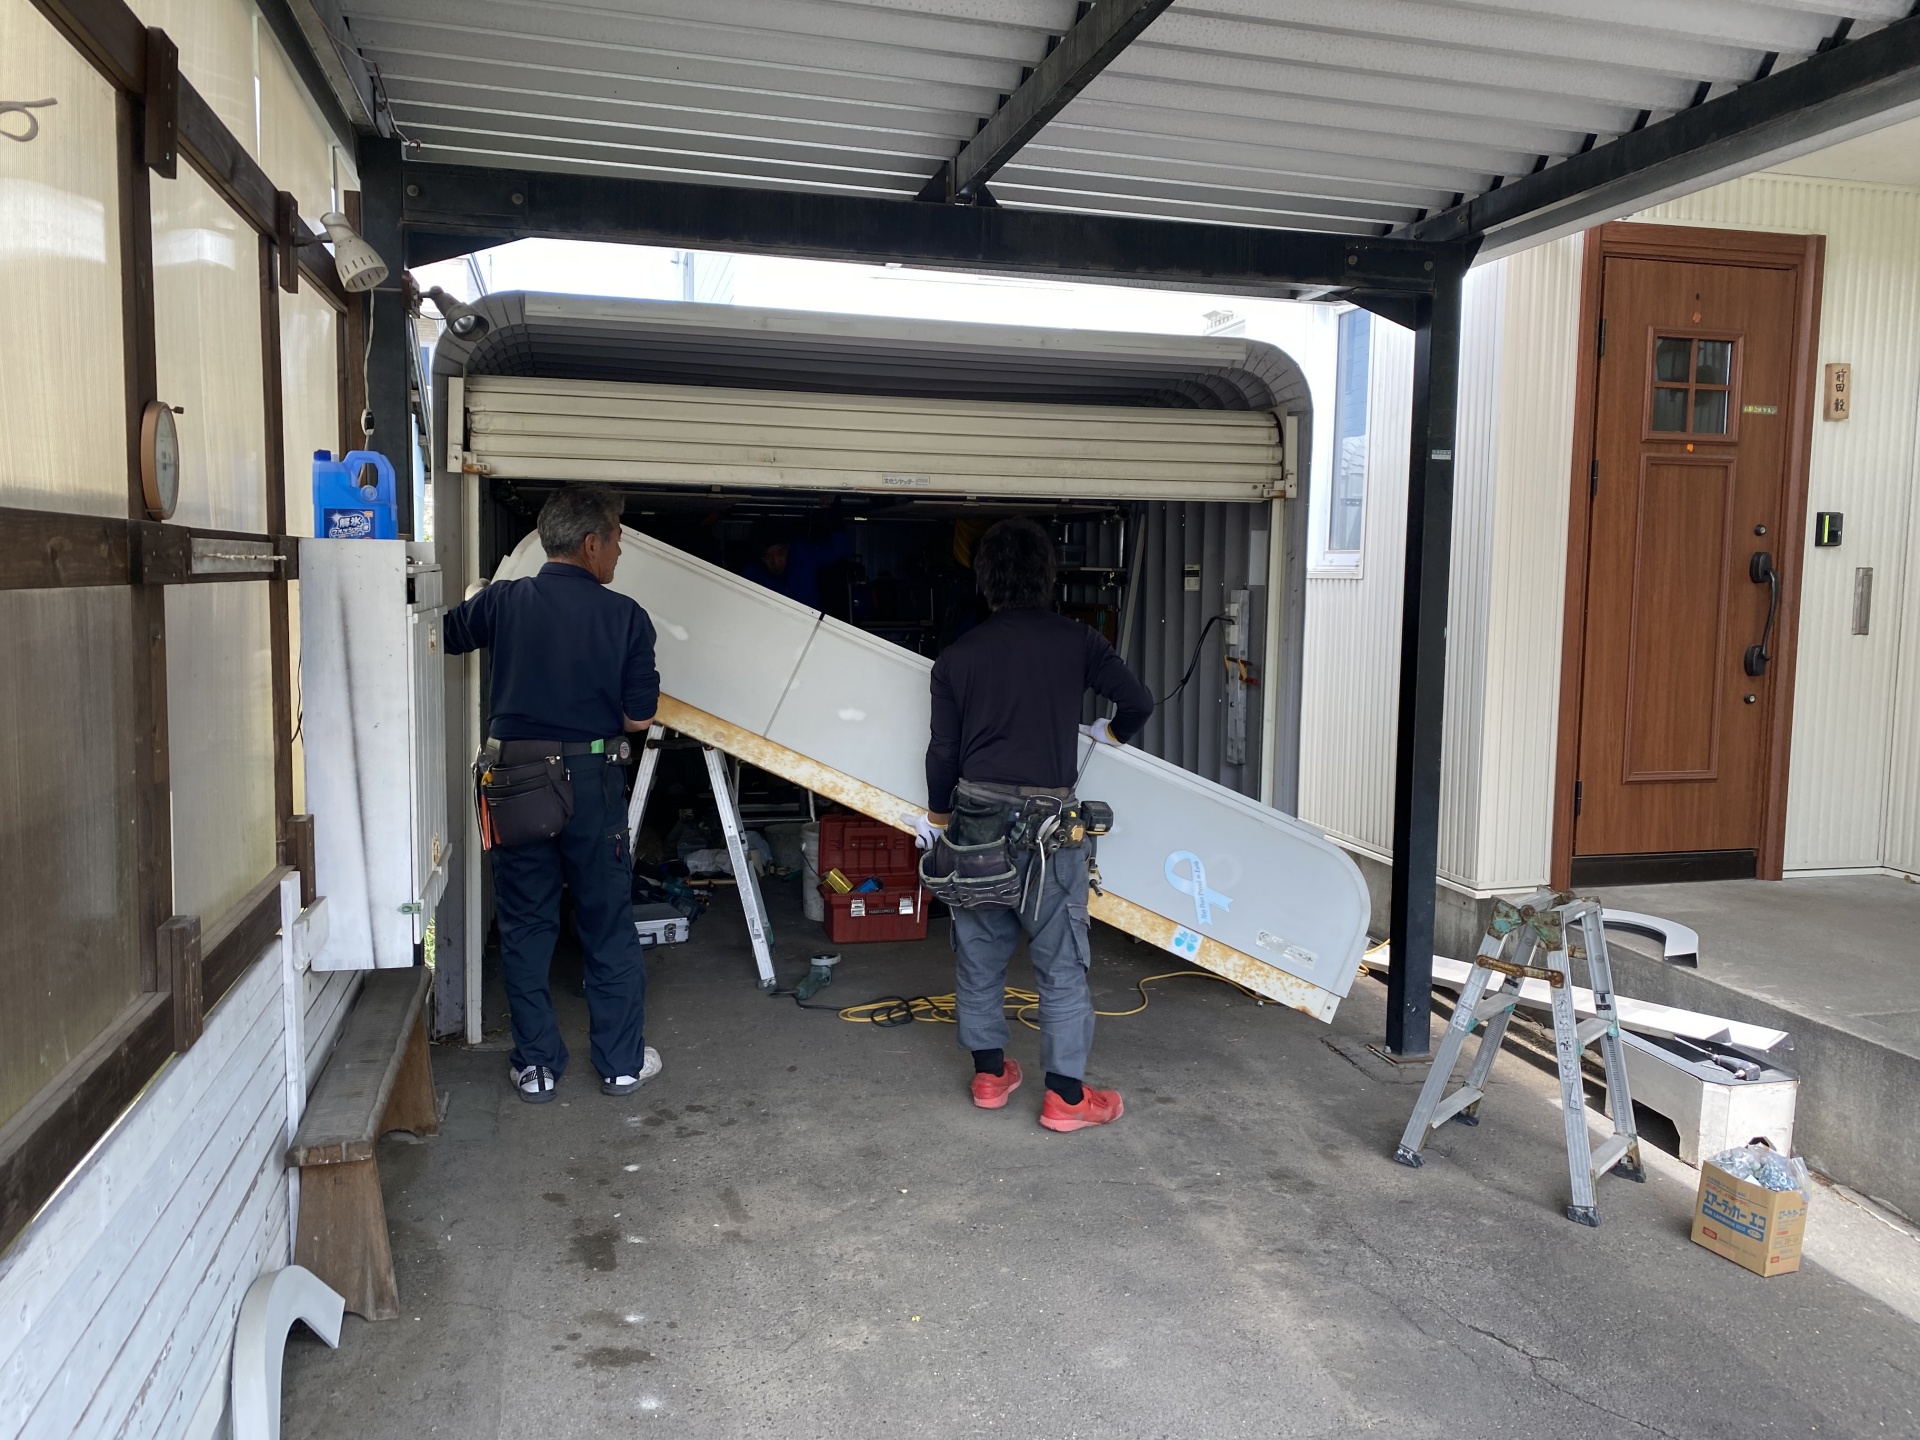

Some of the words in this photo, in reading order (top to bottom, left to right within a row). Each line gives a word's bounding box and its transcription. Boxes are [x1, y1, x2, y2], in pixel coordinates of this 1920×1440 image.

[1703, 1189, 1747, 1220] エアーラッカー
[1749, 1212, 1767, 1231] エコ
